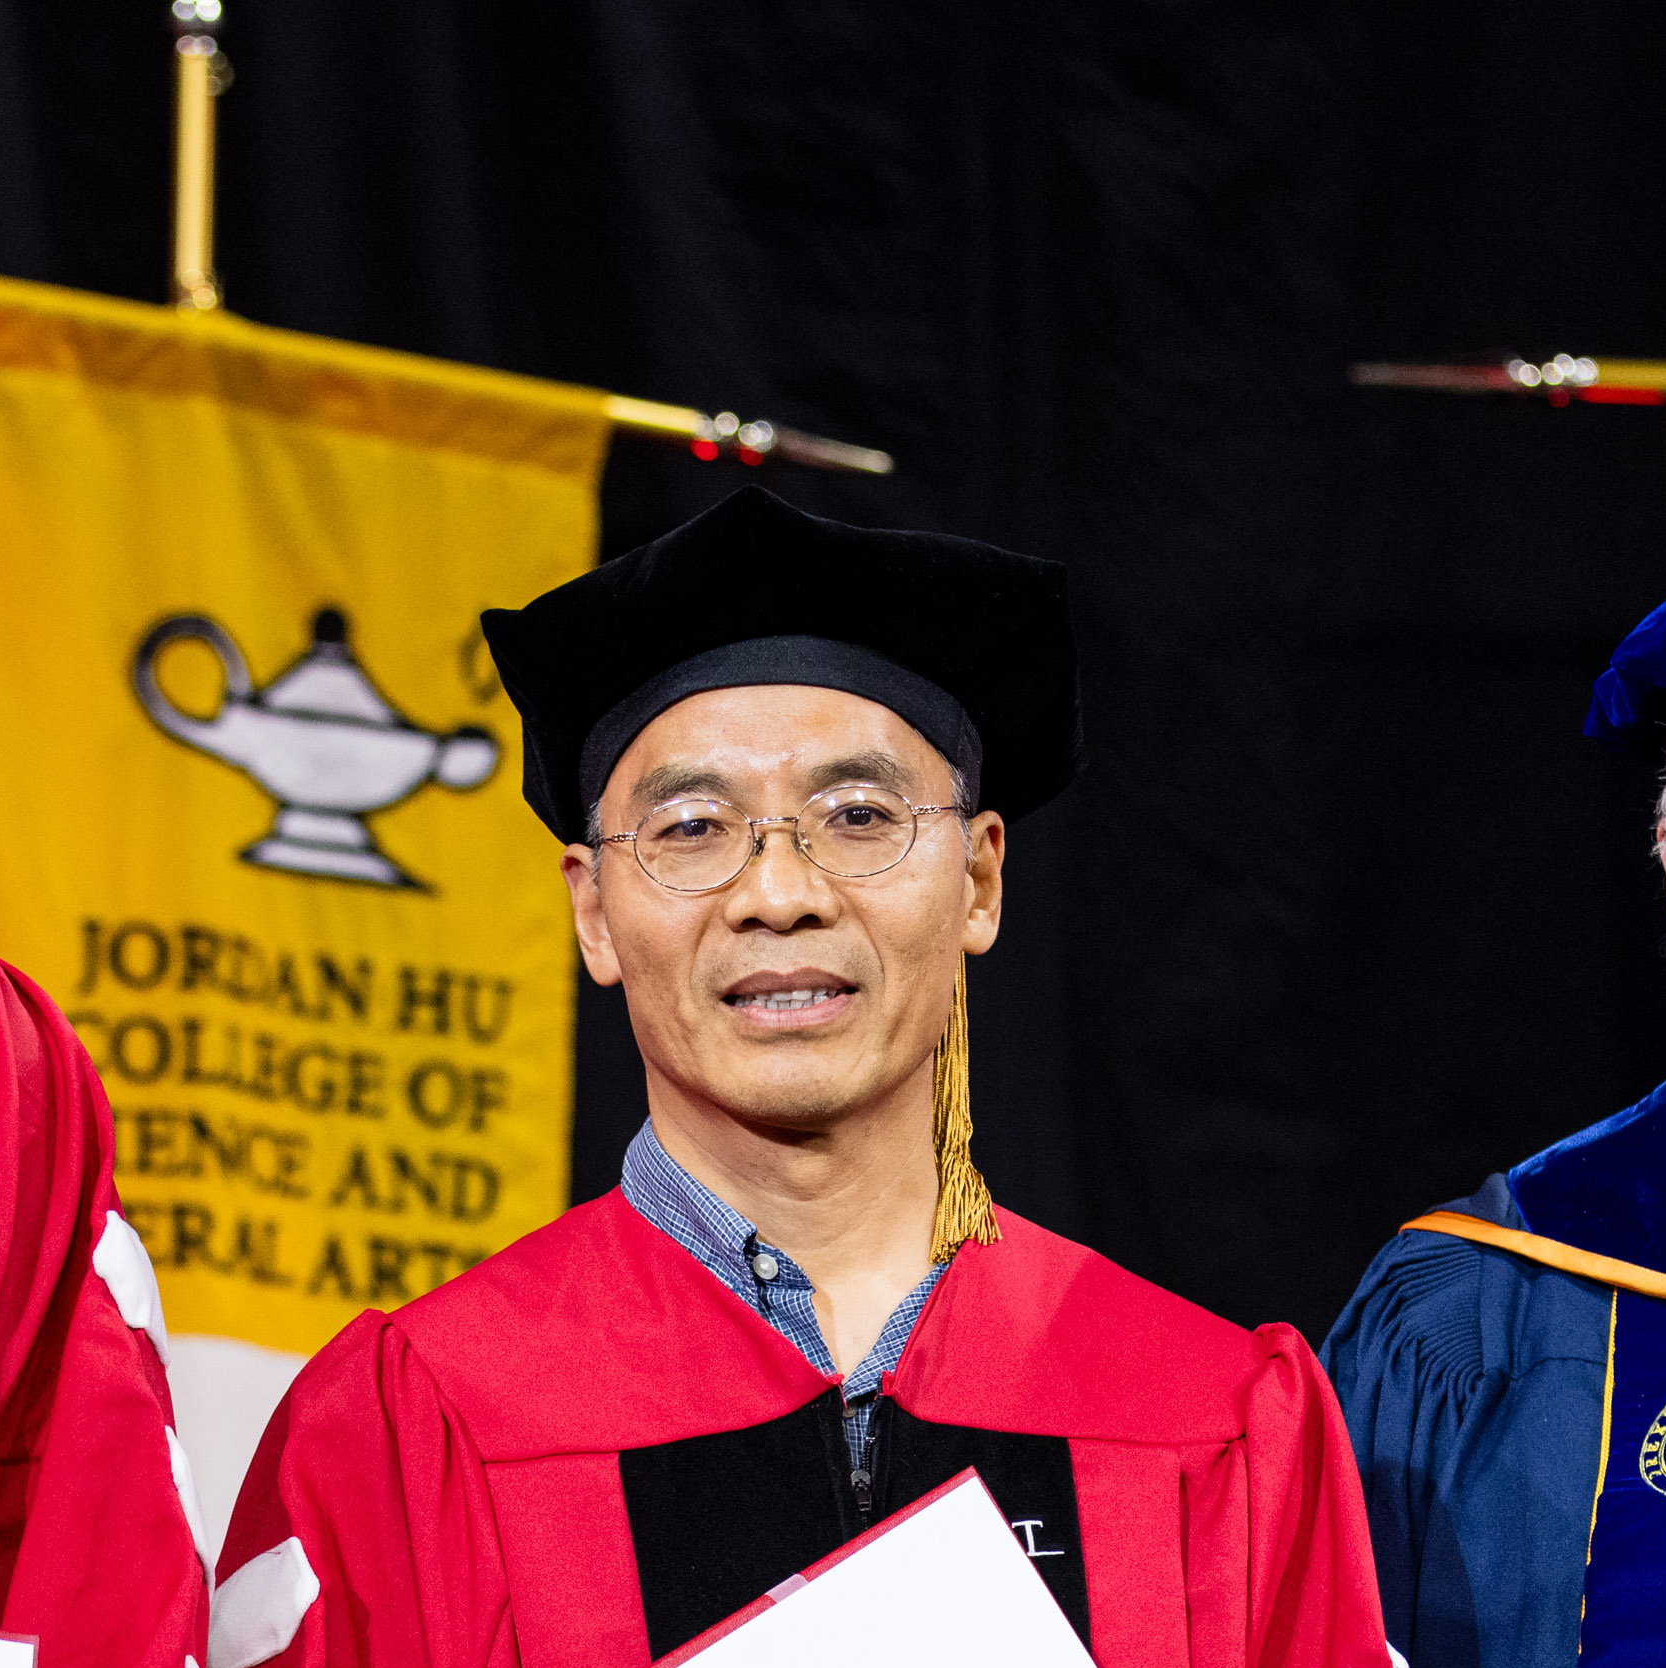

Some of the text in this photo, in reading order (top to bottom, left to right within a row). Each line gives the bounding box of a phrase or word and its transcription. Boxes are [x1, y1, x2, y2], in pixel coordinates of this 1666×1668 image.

[75, 915, 517, 1047] JORDAN HU
[405, 1057, 511, 1135] OF
[328, 1143, 503, 1226] AND
[306, 1230, 490, 1306] ART
